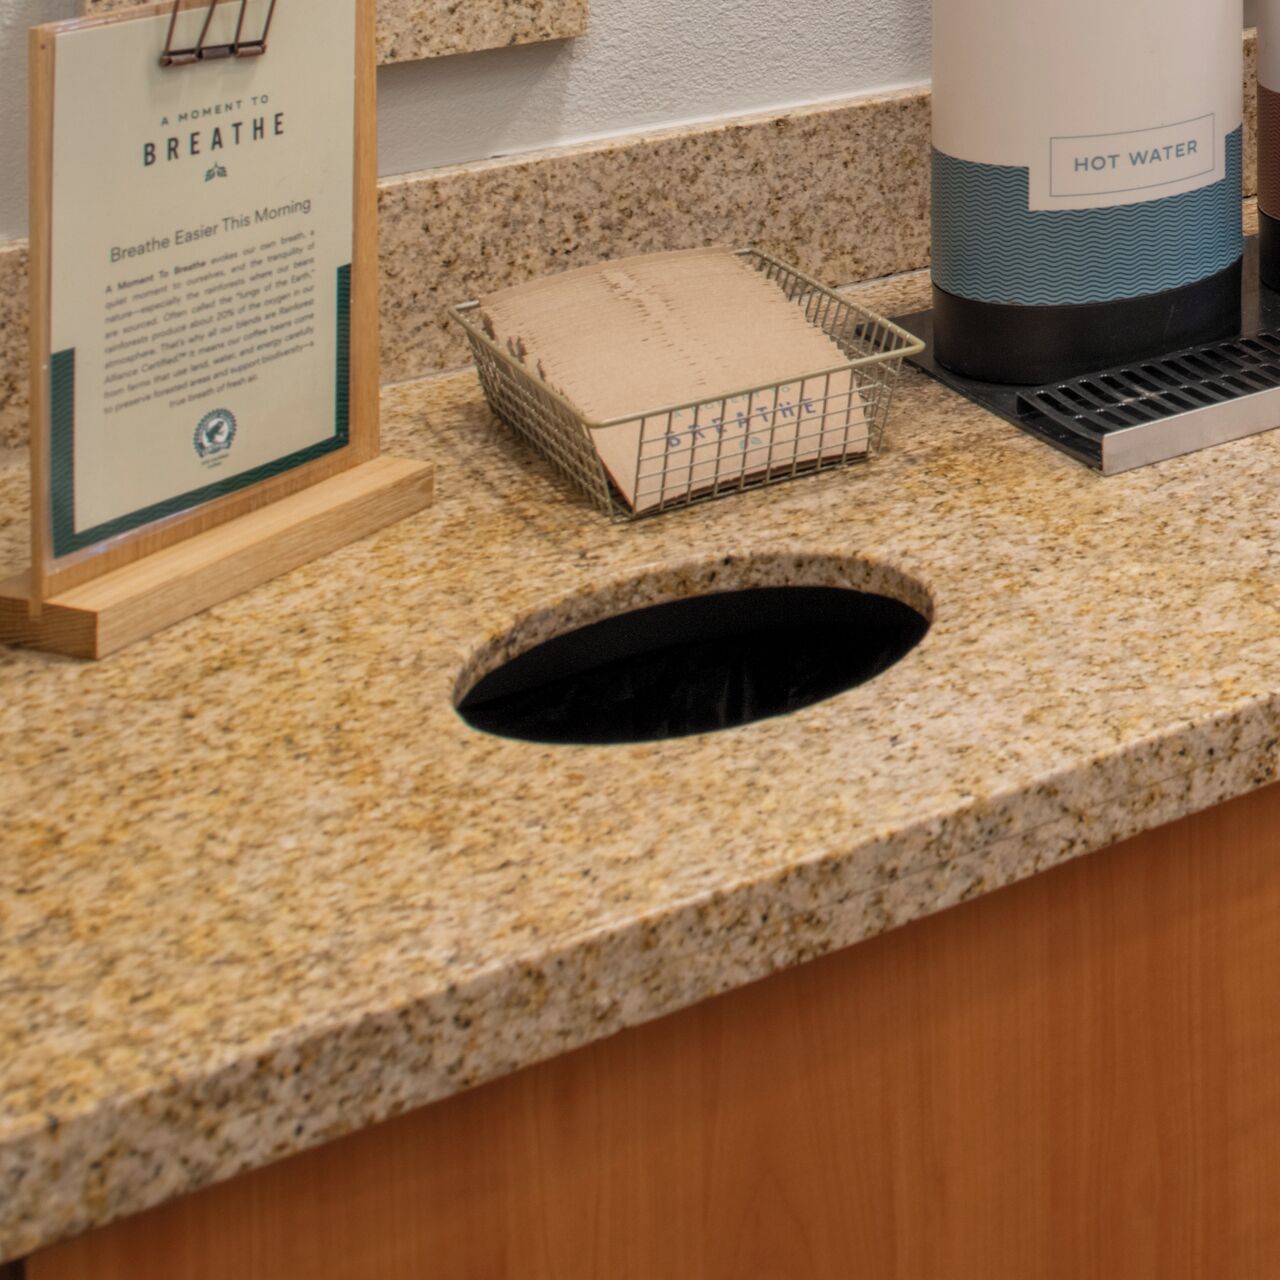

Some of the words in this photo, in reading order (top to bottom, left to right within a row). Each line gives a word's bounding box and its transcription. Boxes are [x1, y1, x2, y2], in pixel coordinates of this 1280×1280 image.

[161, 117, 169, 126] A
[178, 100, 243, 123] MOMENT
[251, 94, 269, 106] TO
[143, 112, 284, 167] BREATHE
[1073, 153, 1120, 173] HOT
[1128, 140, 1199, 167] WATER
[110, 236, 170, 263] Breathe
[175, 224, 219, 246] Easier
[221, 214, 251, 232] This
[254, 199, 311, 223] Morning
[118, 274, 154, 290] Moment
[174, 261, 206, 275] Breathe
